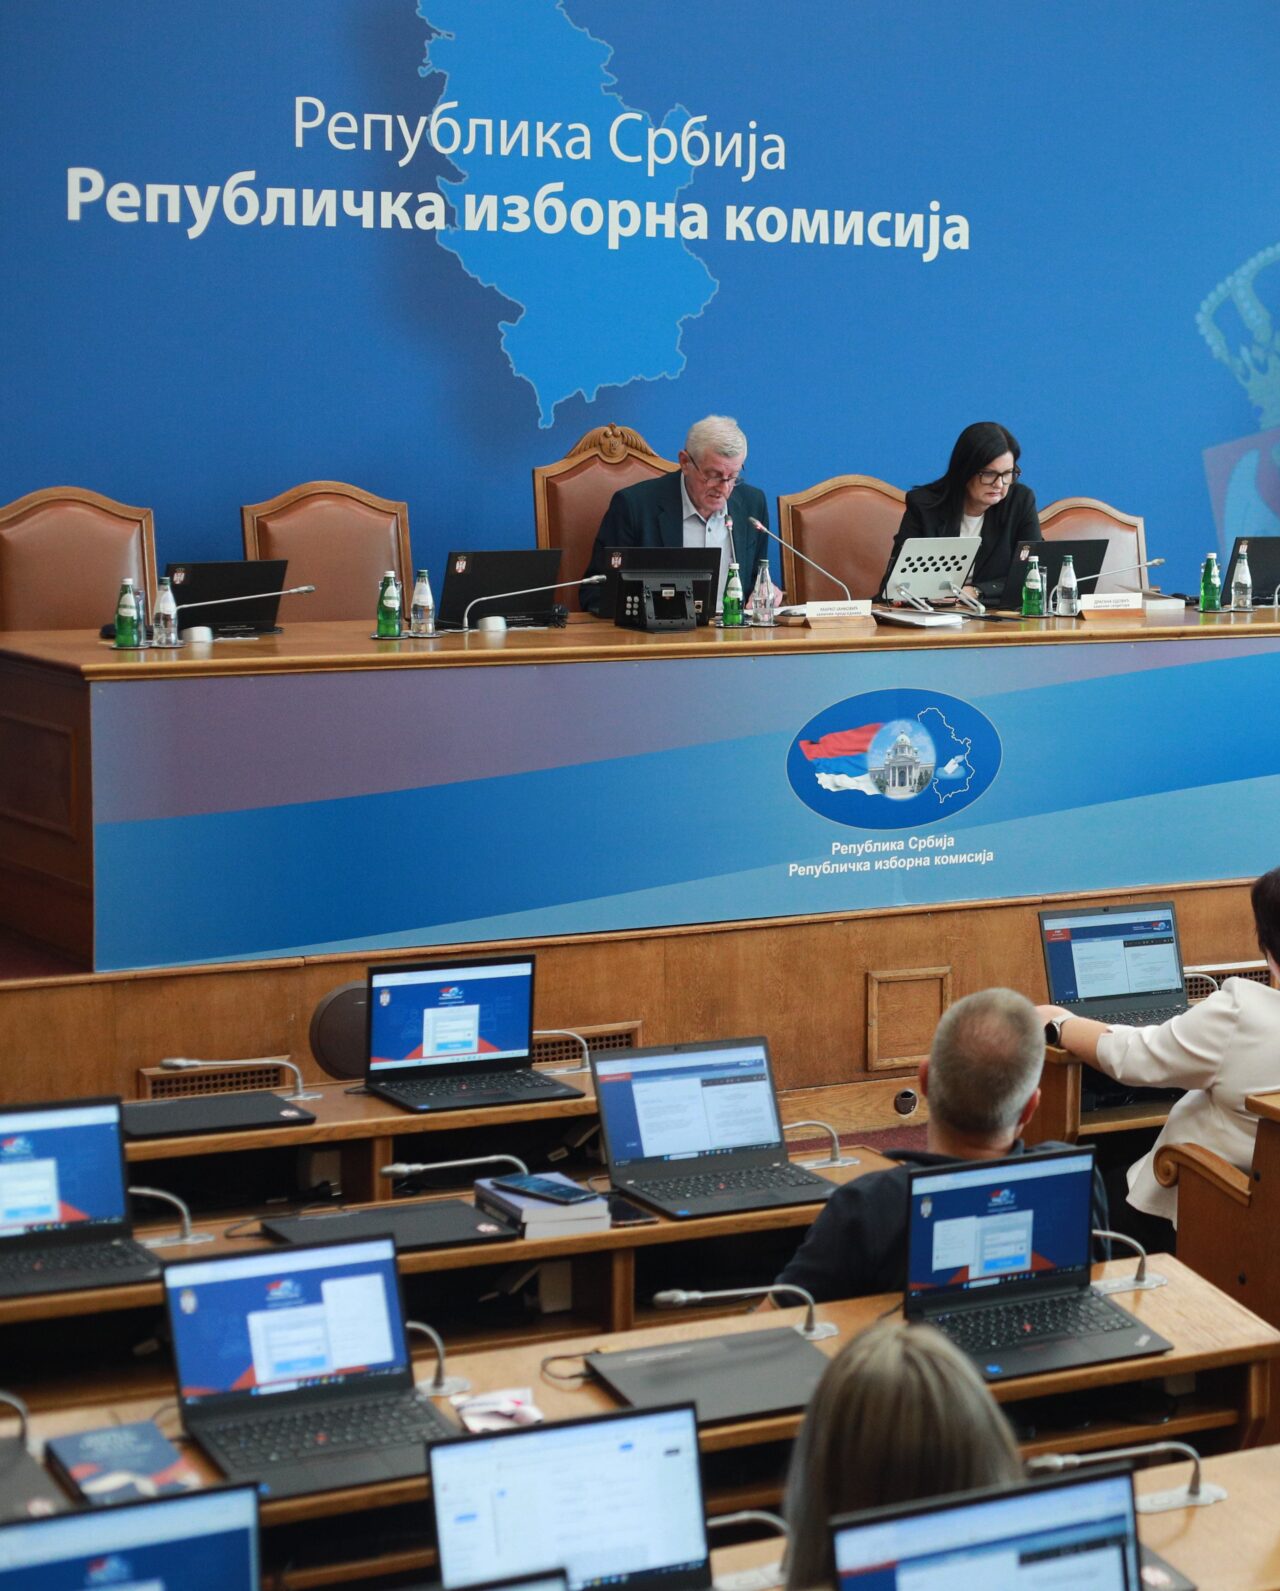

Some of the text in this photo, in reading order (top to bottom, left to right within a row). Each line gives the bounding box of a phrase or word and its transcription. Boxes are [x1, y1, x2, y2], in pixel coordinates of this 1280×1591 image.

[294, 96, 787, 183] Република Србија
[67, 167, 970, 263] Републичка изборна комисија
[789, 850, 994, 878] Републичка изборна комисија
[831, 834, 956, 858] Република Србија
